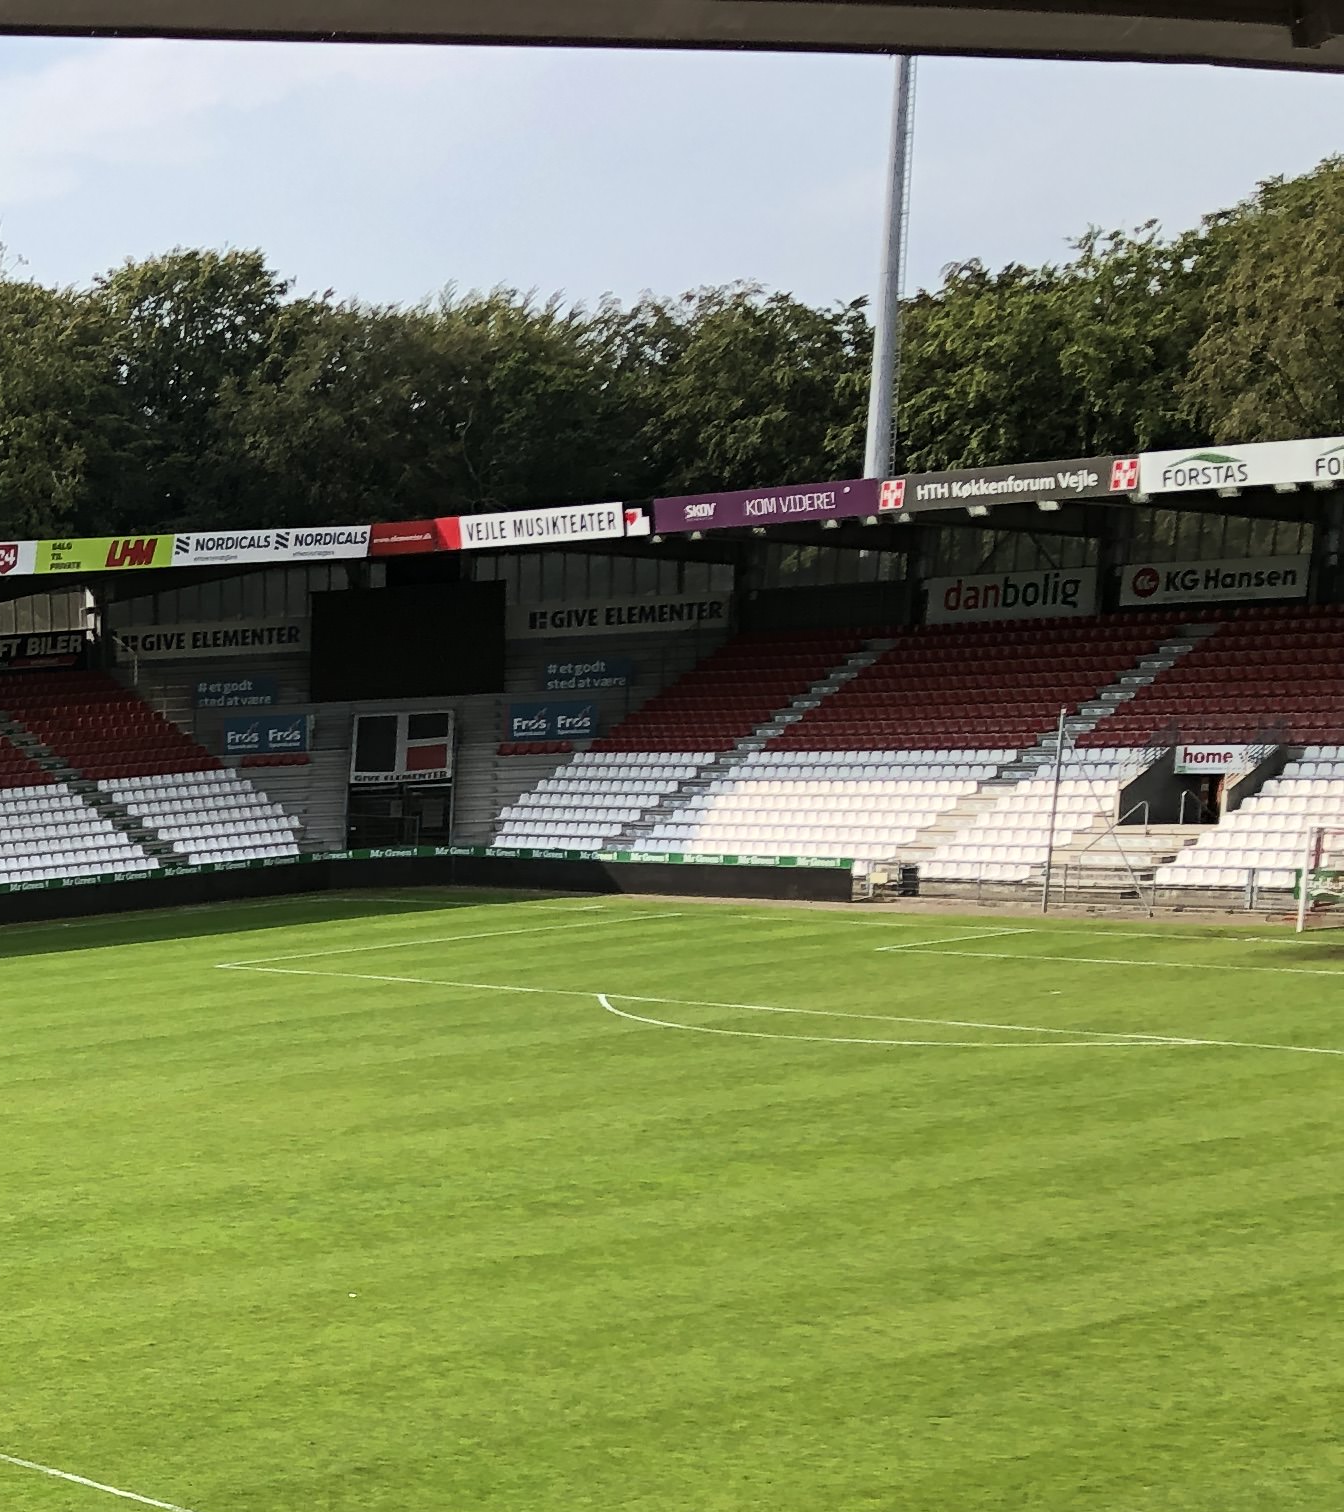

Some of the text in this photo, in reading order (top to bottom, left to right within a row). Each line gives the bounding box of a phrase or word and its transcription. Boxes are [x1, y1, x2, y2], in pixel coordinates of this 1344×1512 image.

[916, 469, 1098, 501] HTH Køkkenforum Vejle
[1163, 463, 1248, 488] FORSTAS
[745, 491, 836, 516] KOM VIDERE!
[293, 530, 368, 547] NORDICALS
[466, 511, 618, 542] VEJLE MUSIKTEATER
[194, 535, 272, 552] NORDICALS
[1164, 566, 1297, 592] KG Hansen
[943, 573, 1081, 611] danbolig
[551, 600, 723, 629] GIVE ELEMENTER
[26, 634, 83, 657] BILER
[142, 626, 300, 651] GIVE ELEMENTER
[574, 661, 606, 677] godt
[223, 679, 253, 695] godt
[1183, 747, 1234, 765] home
